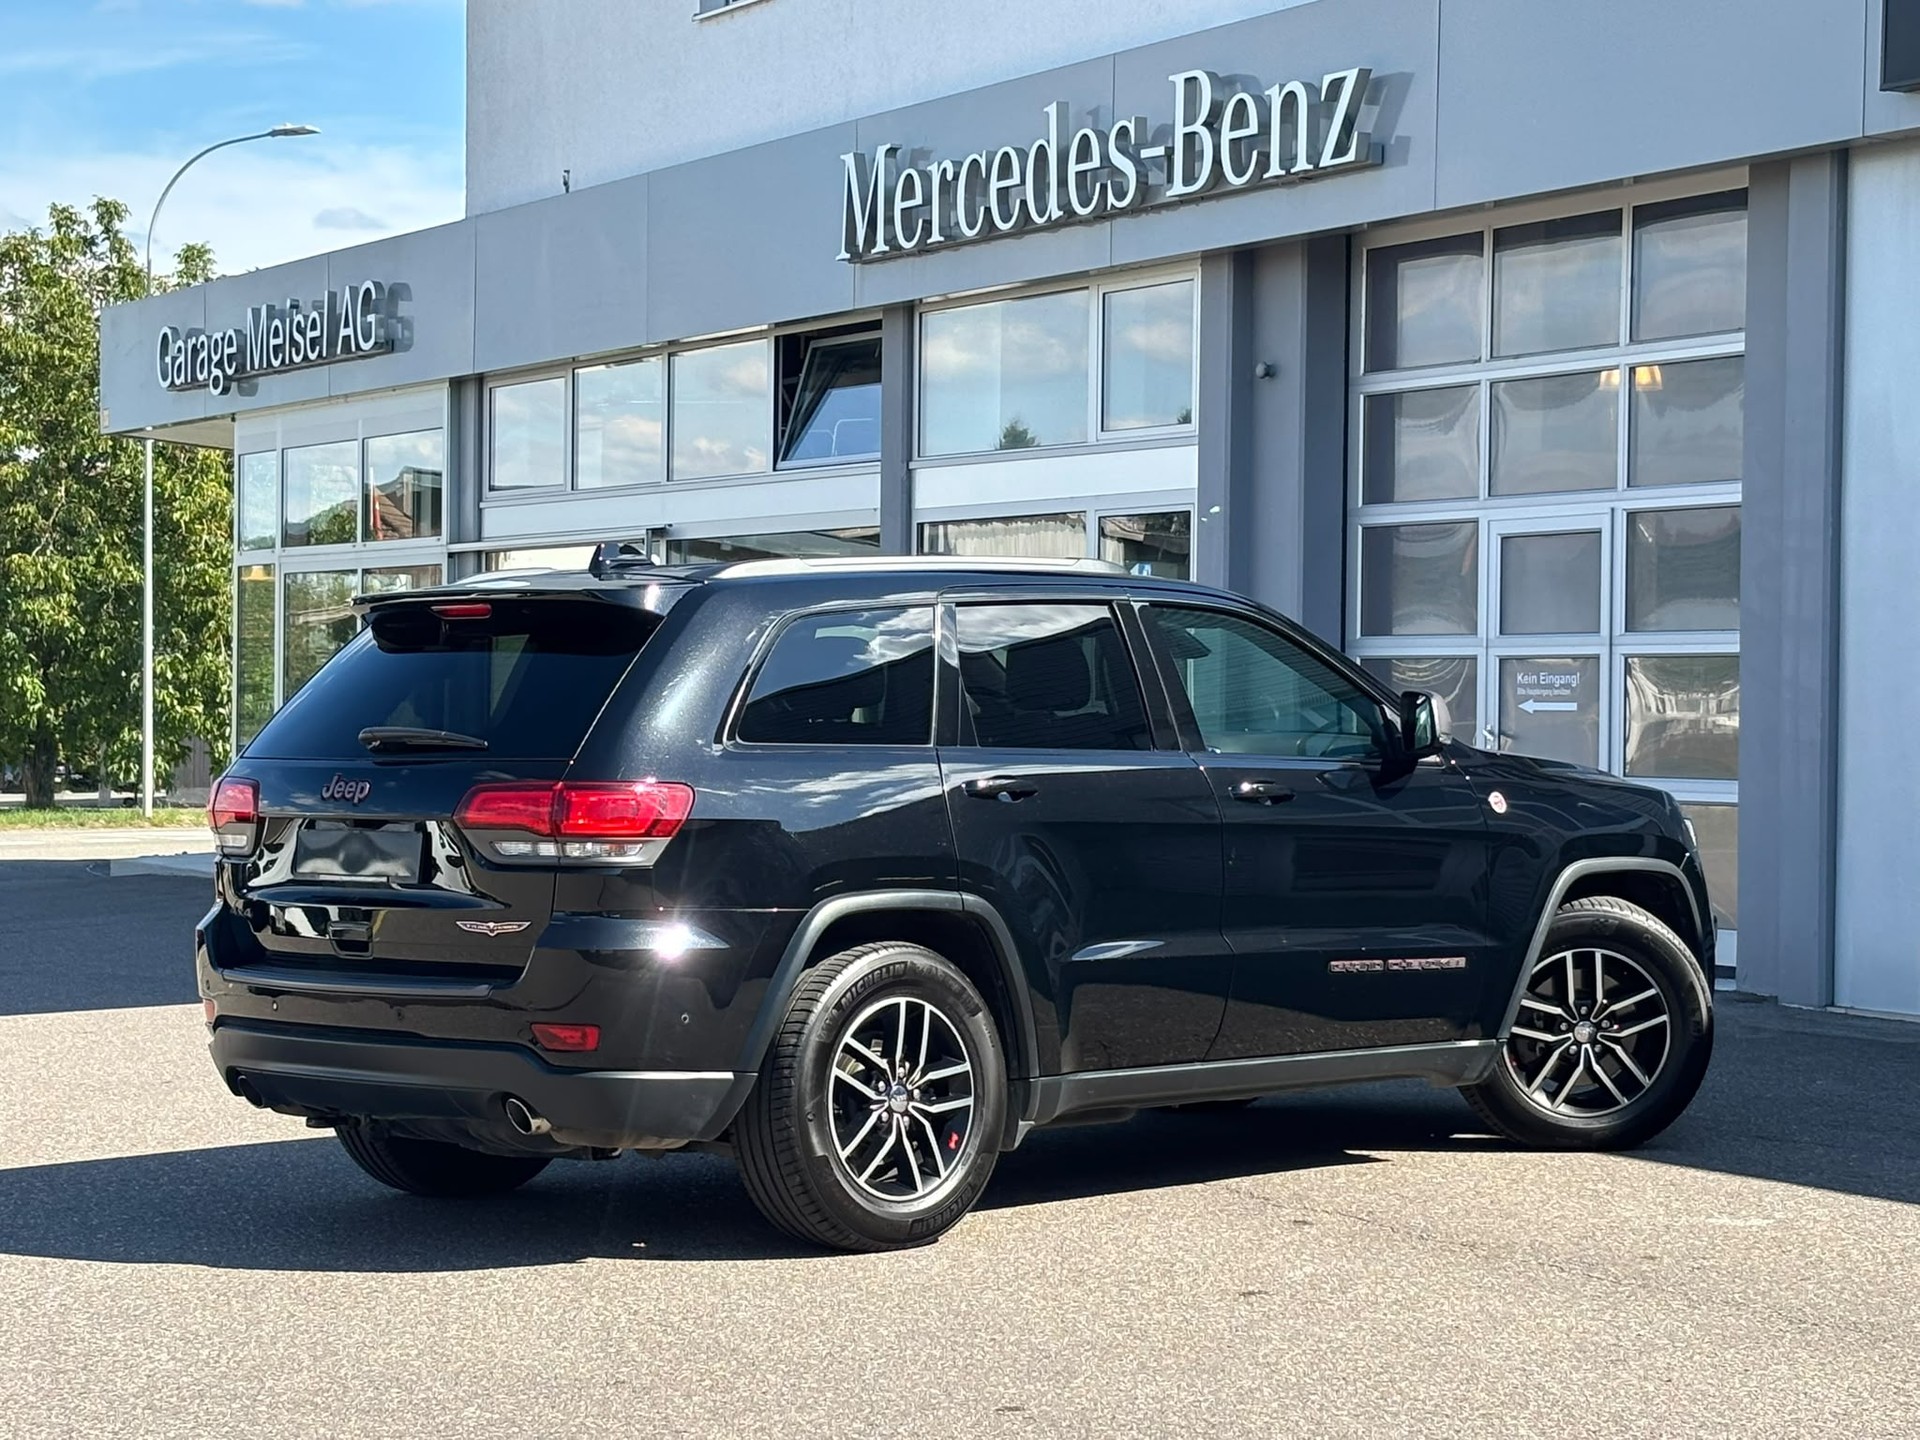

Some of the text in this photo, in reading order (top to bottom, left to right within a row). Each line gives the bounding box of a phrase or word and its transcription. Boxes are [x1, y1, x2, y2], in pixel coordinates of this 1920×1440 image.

[836, 67, 1372, 261] Mercedes-Benz
[157, 280, 377, 396] Garage Meisel AG
[1517, 672, 1580, 687] Kein Eingang!
[321, 773, 371, 804] Jeep
[840, 960, 907, 1009] MICHELIN
